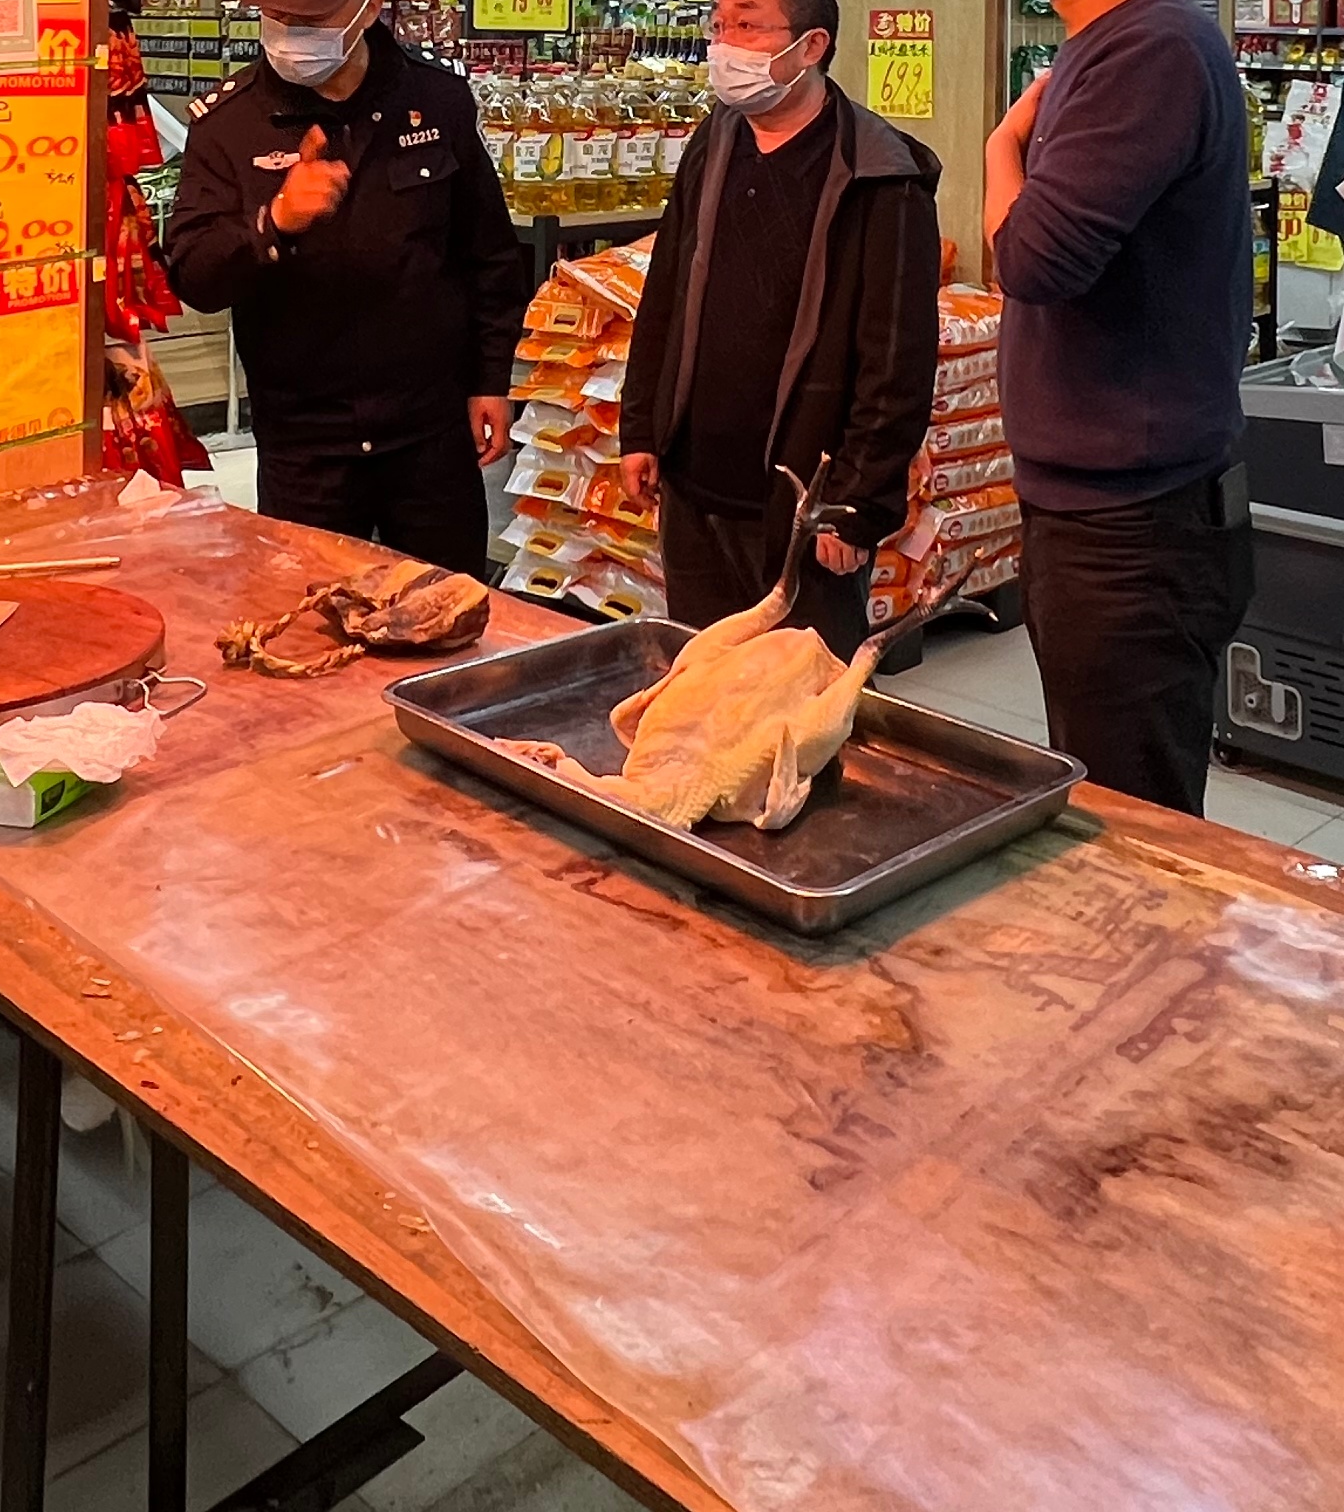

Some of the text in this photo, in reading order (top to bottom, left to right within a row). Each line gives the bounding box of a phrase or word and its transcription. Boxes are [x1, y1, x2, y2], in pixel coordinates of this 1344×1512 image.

[398, 128, 441, 148] 012212
[2, 260, 72, 300] 特价
[7, 291, 72, 309] PROMOTION
